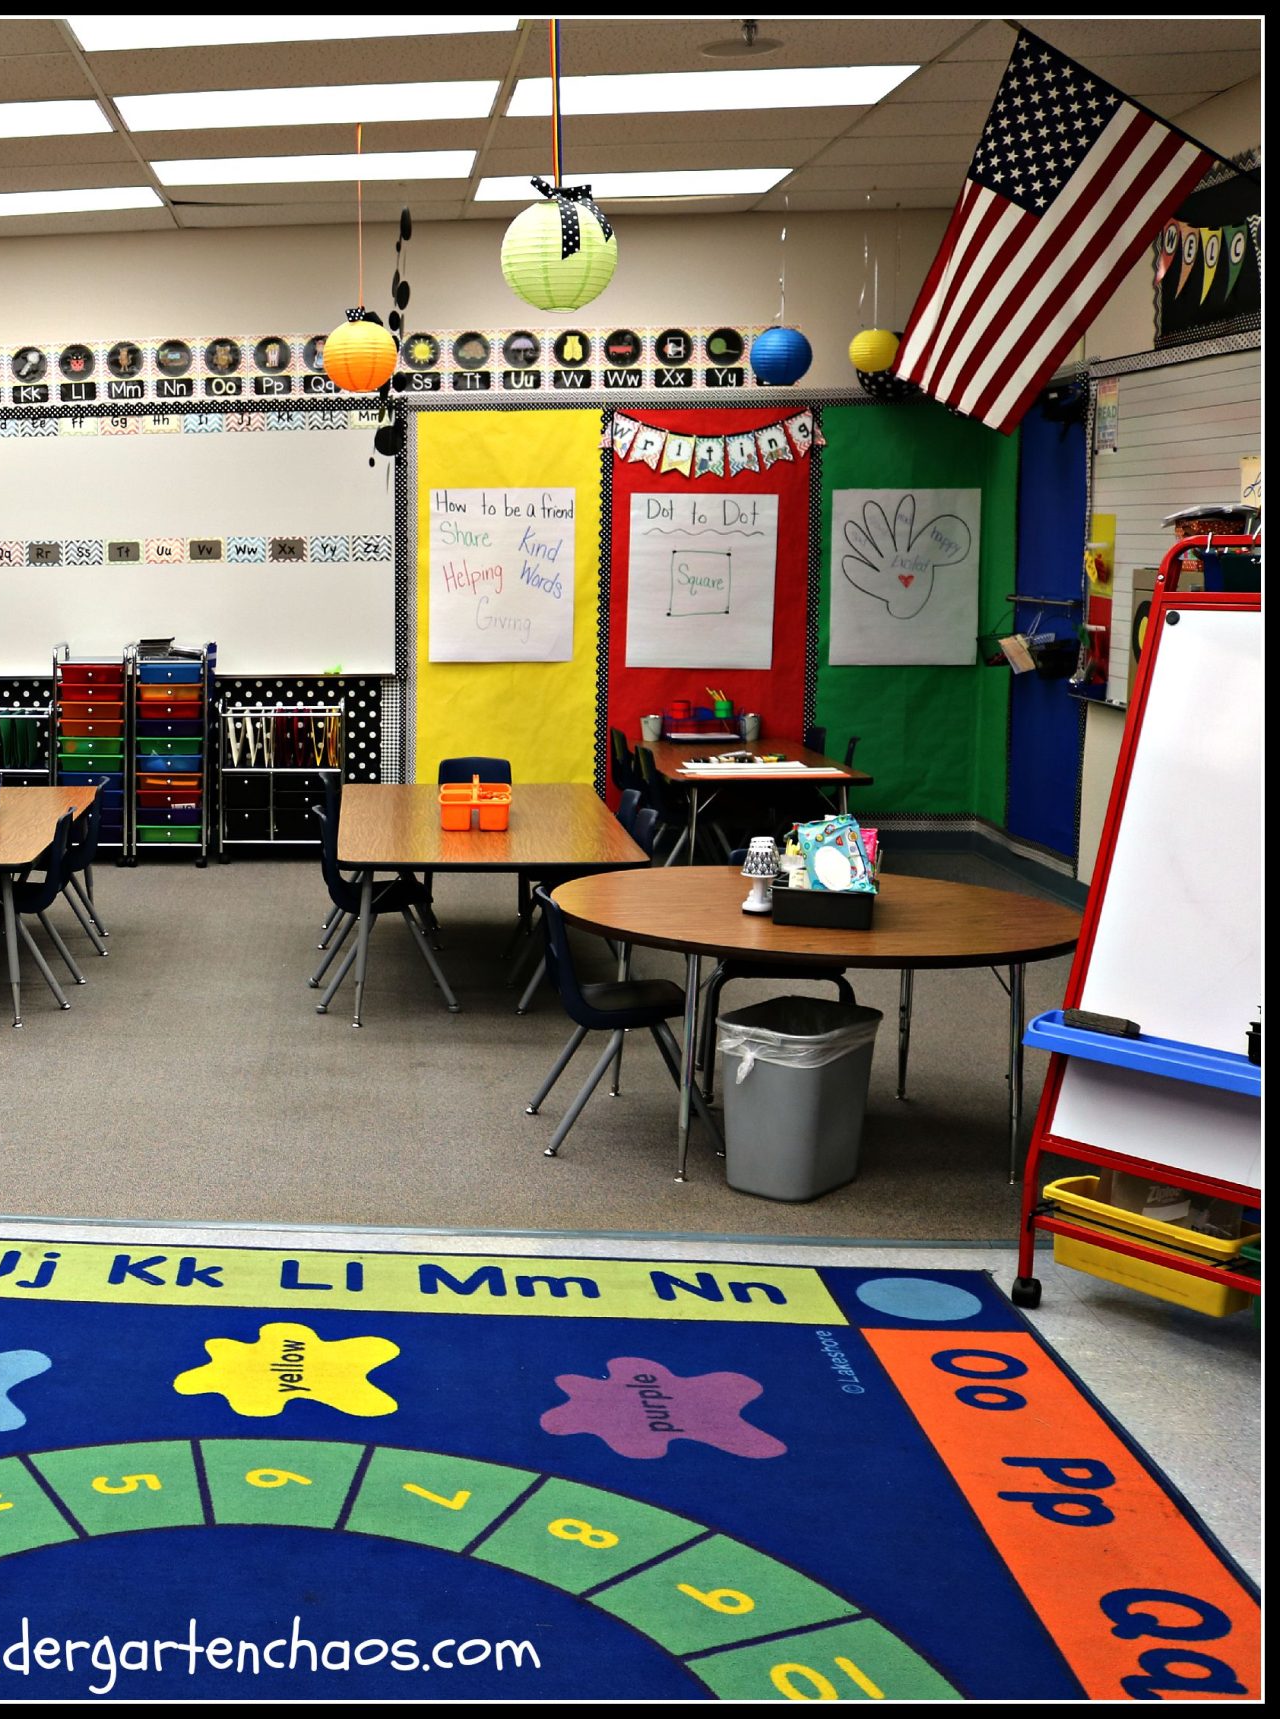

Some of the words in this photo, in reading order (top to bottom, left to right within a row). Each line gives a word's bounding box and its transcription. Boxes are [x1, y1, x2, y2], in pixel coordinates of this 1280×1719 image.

[19, 387, 41, 401] Kk
[71, 384, 86, 400] Ll
[111, 382, 142, 398] Mm
[163, 380, 187, 396] Nn
[211, 378, 237, 395] Oo
[262, 377, 284, 393] Pp
[311, 376, 335, 393] Qq
[411, 374, 433, 390] Ss
[462, 372, 481, 389] Tt
[510, 372, 535, 388] Uu
[561, 371, 584, 388] Vv
[606, 370, 640, 387] Ww
[661, 368, 686, 386] Xx
[715, 369, 737, 387] Yy
[111, 416, 127, 428] Gg
[153, 415, 169, 425] Hh
[197, 413, 209, 425] Ii
[358, 410, 380, 421] Mm
[436, 490, 467, 513] How
[481, 493, 497, 516] to
[505, 493, 521, 517] be
[526, 503, 536, 518] a
[541, 492, 574, 519] friend
[647, 498, 674, 520] Dot
[691, 501, 707, 525] to
[723, 499, 759, 526] Dot
[36, 548, 51, 560] Rr
[76, 546, 91, 558] Ss
[116, 546, 131, 558] Tt
[156, 545, 171, 557] Uu
[235, 544, 258, 555] Ww
[278, 543, 295, 556] Xx
[321, 544, 337, 557] Yy
[363, 543, 380, 554] Zz
[439, 521, 492, 548] Share
[518, 525, 563, 563] Kind
[443, 559, 504, 596] Helping
[520, 560, 563, 599] Words
[678, 563, 724, 596] Square
[475, 595, 532, 644] Giving
[108, 1254, 224, 1288] Kk
[280, 1259, 363, 1292] Ll
[418, 1263, 600, 1299] Mm
[650, 1270, 788, 1305] Nn
[270, 1339, 311, 1392] yellow
[626, 1374, 685, 1432] purple
[931, 1348, 1028, 1411] Oo
[997, 1456, 1116, 1527] Pp
[1100, 1588, 1249, 1700] Qq
[91, 1473, 161, 1495] 5
[245, 1467, 312, 1489] 6
[403, 1482, 472, 1511] 7
[547, 1517, 619, 1549] 8
[676, 1583, 756, 1615] 9
[769, 1656, 885, 1700] 10
